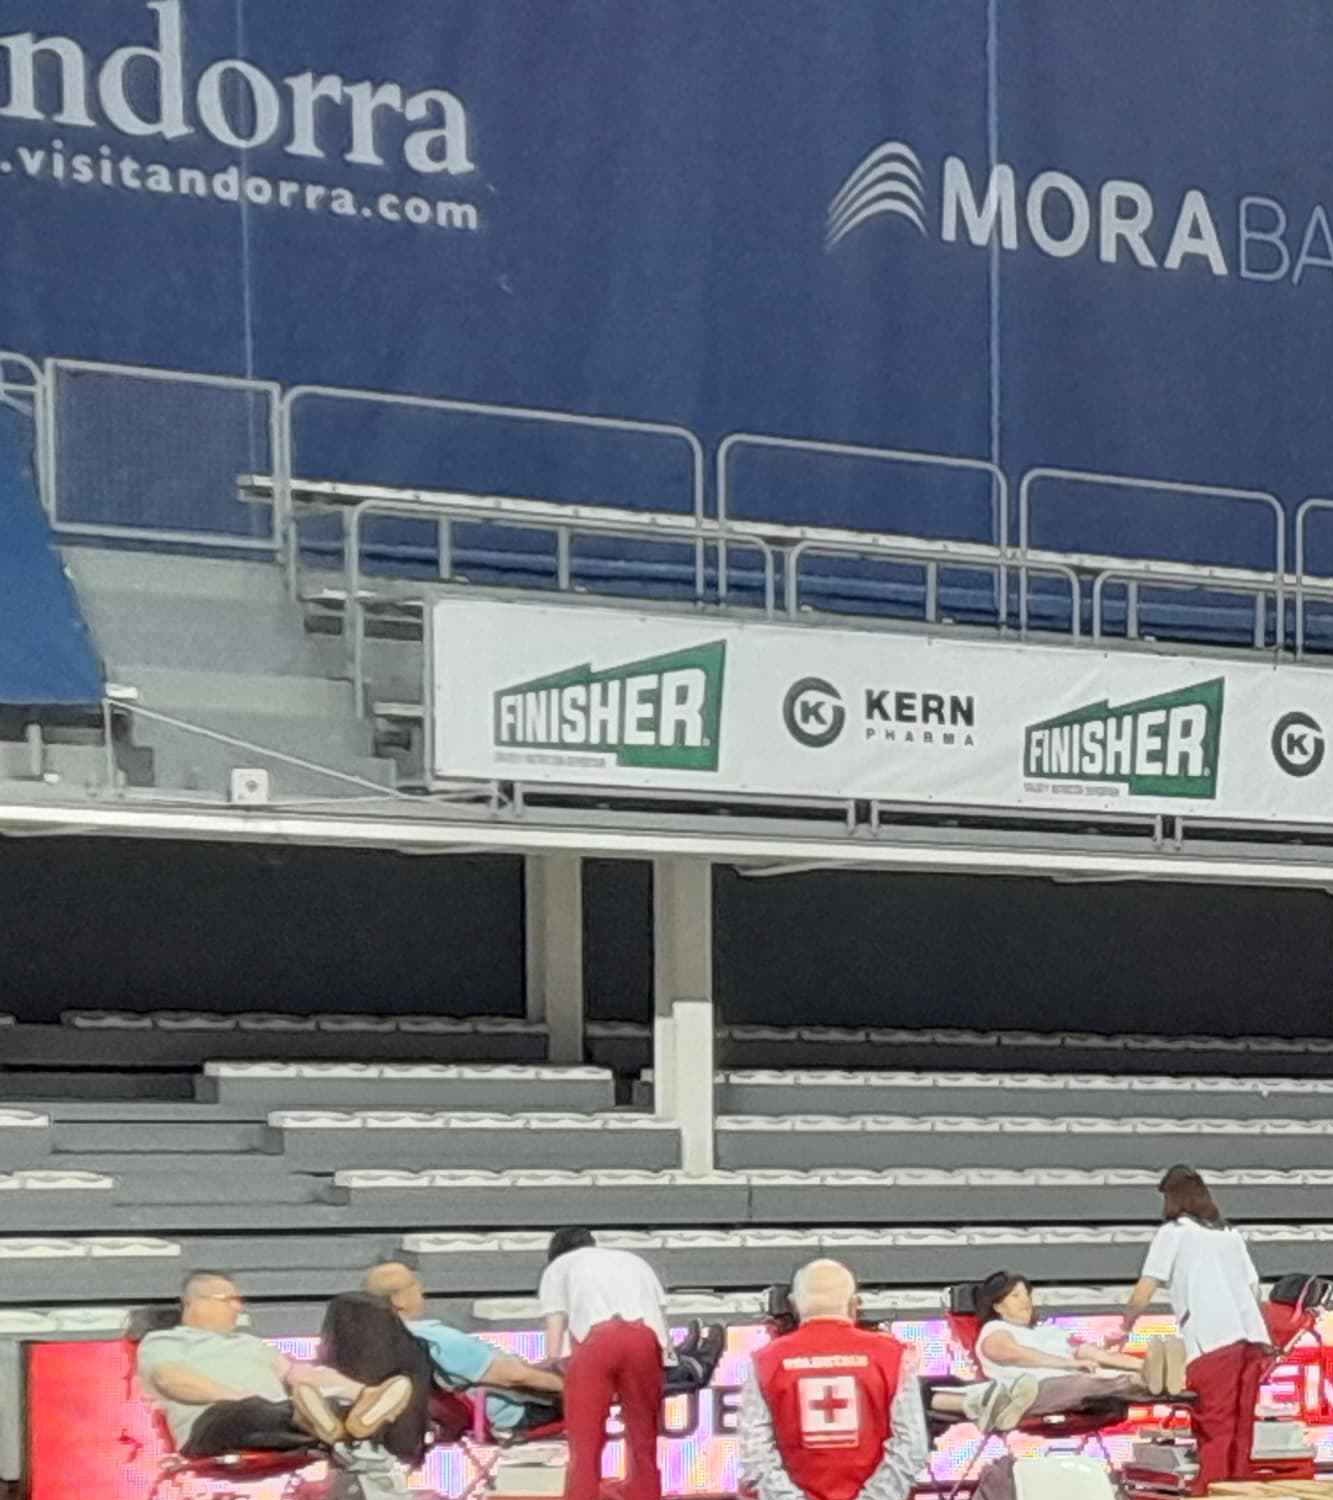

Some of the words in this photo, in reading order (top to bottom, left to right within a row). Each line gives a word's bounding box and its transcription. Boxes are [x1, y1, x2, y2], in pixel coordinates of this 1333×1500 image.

[500, 668, 706, 747] FINISHER
[865, 689, 974, 727] KERN
[865, 727, 975, 747] PHARMA
[1028, 703, 1207, 777] FINISHER
